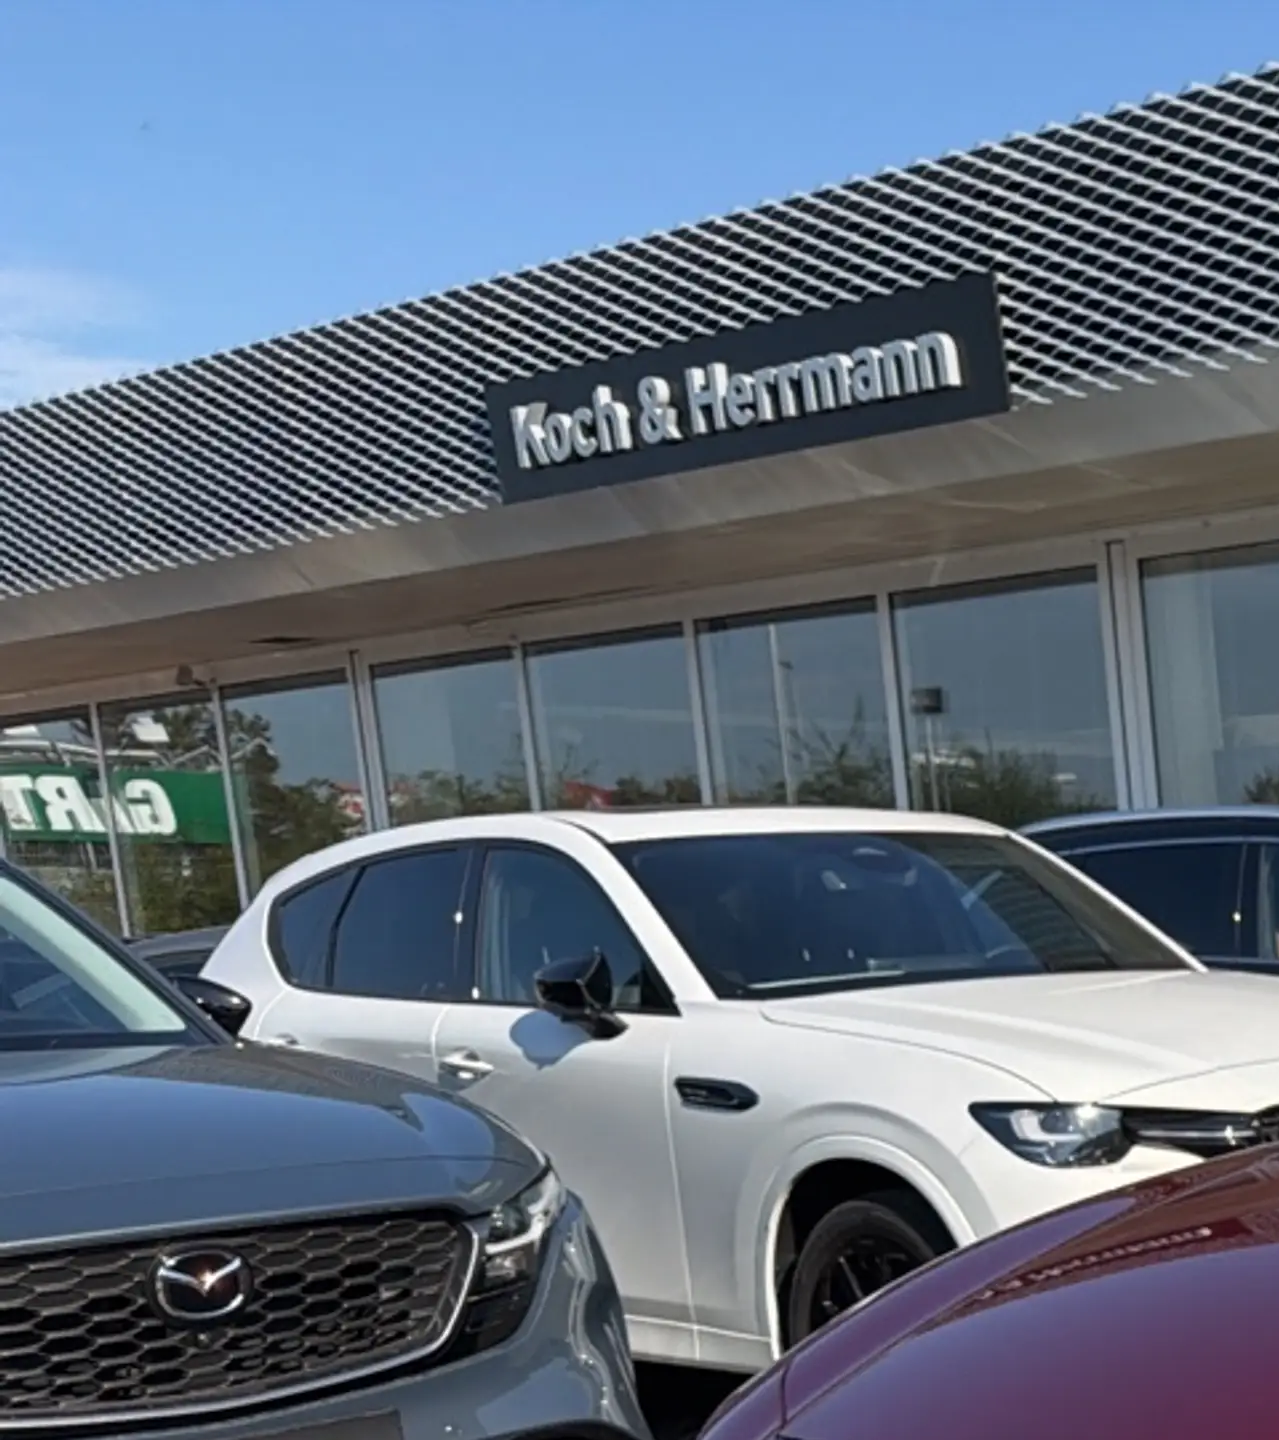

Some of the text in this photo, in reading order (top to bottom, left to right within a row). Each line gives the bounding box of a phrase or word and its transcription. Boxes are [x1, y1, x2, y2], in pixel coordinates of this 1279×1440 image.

[509, 330, 962, 469] Koch & Herrmann
